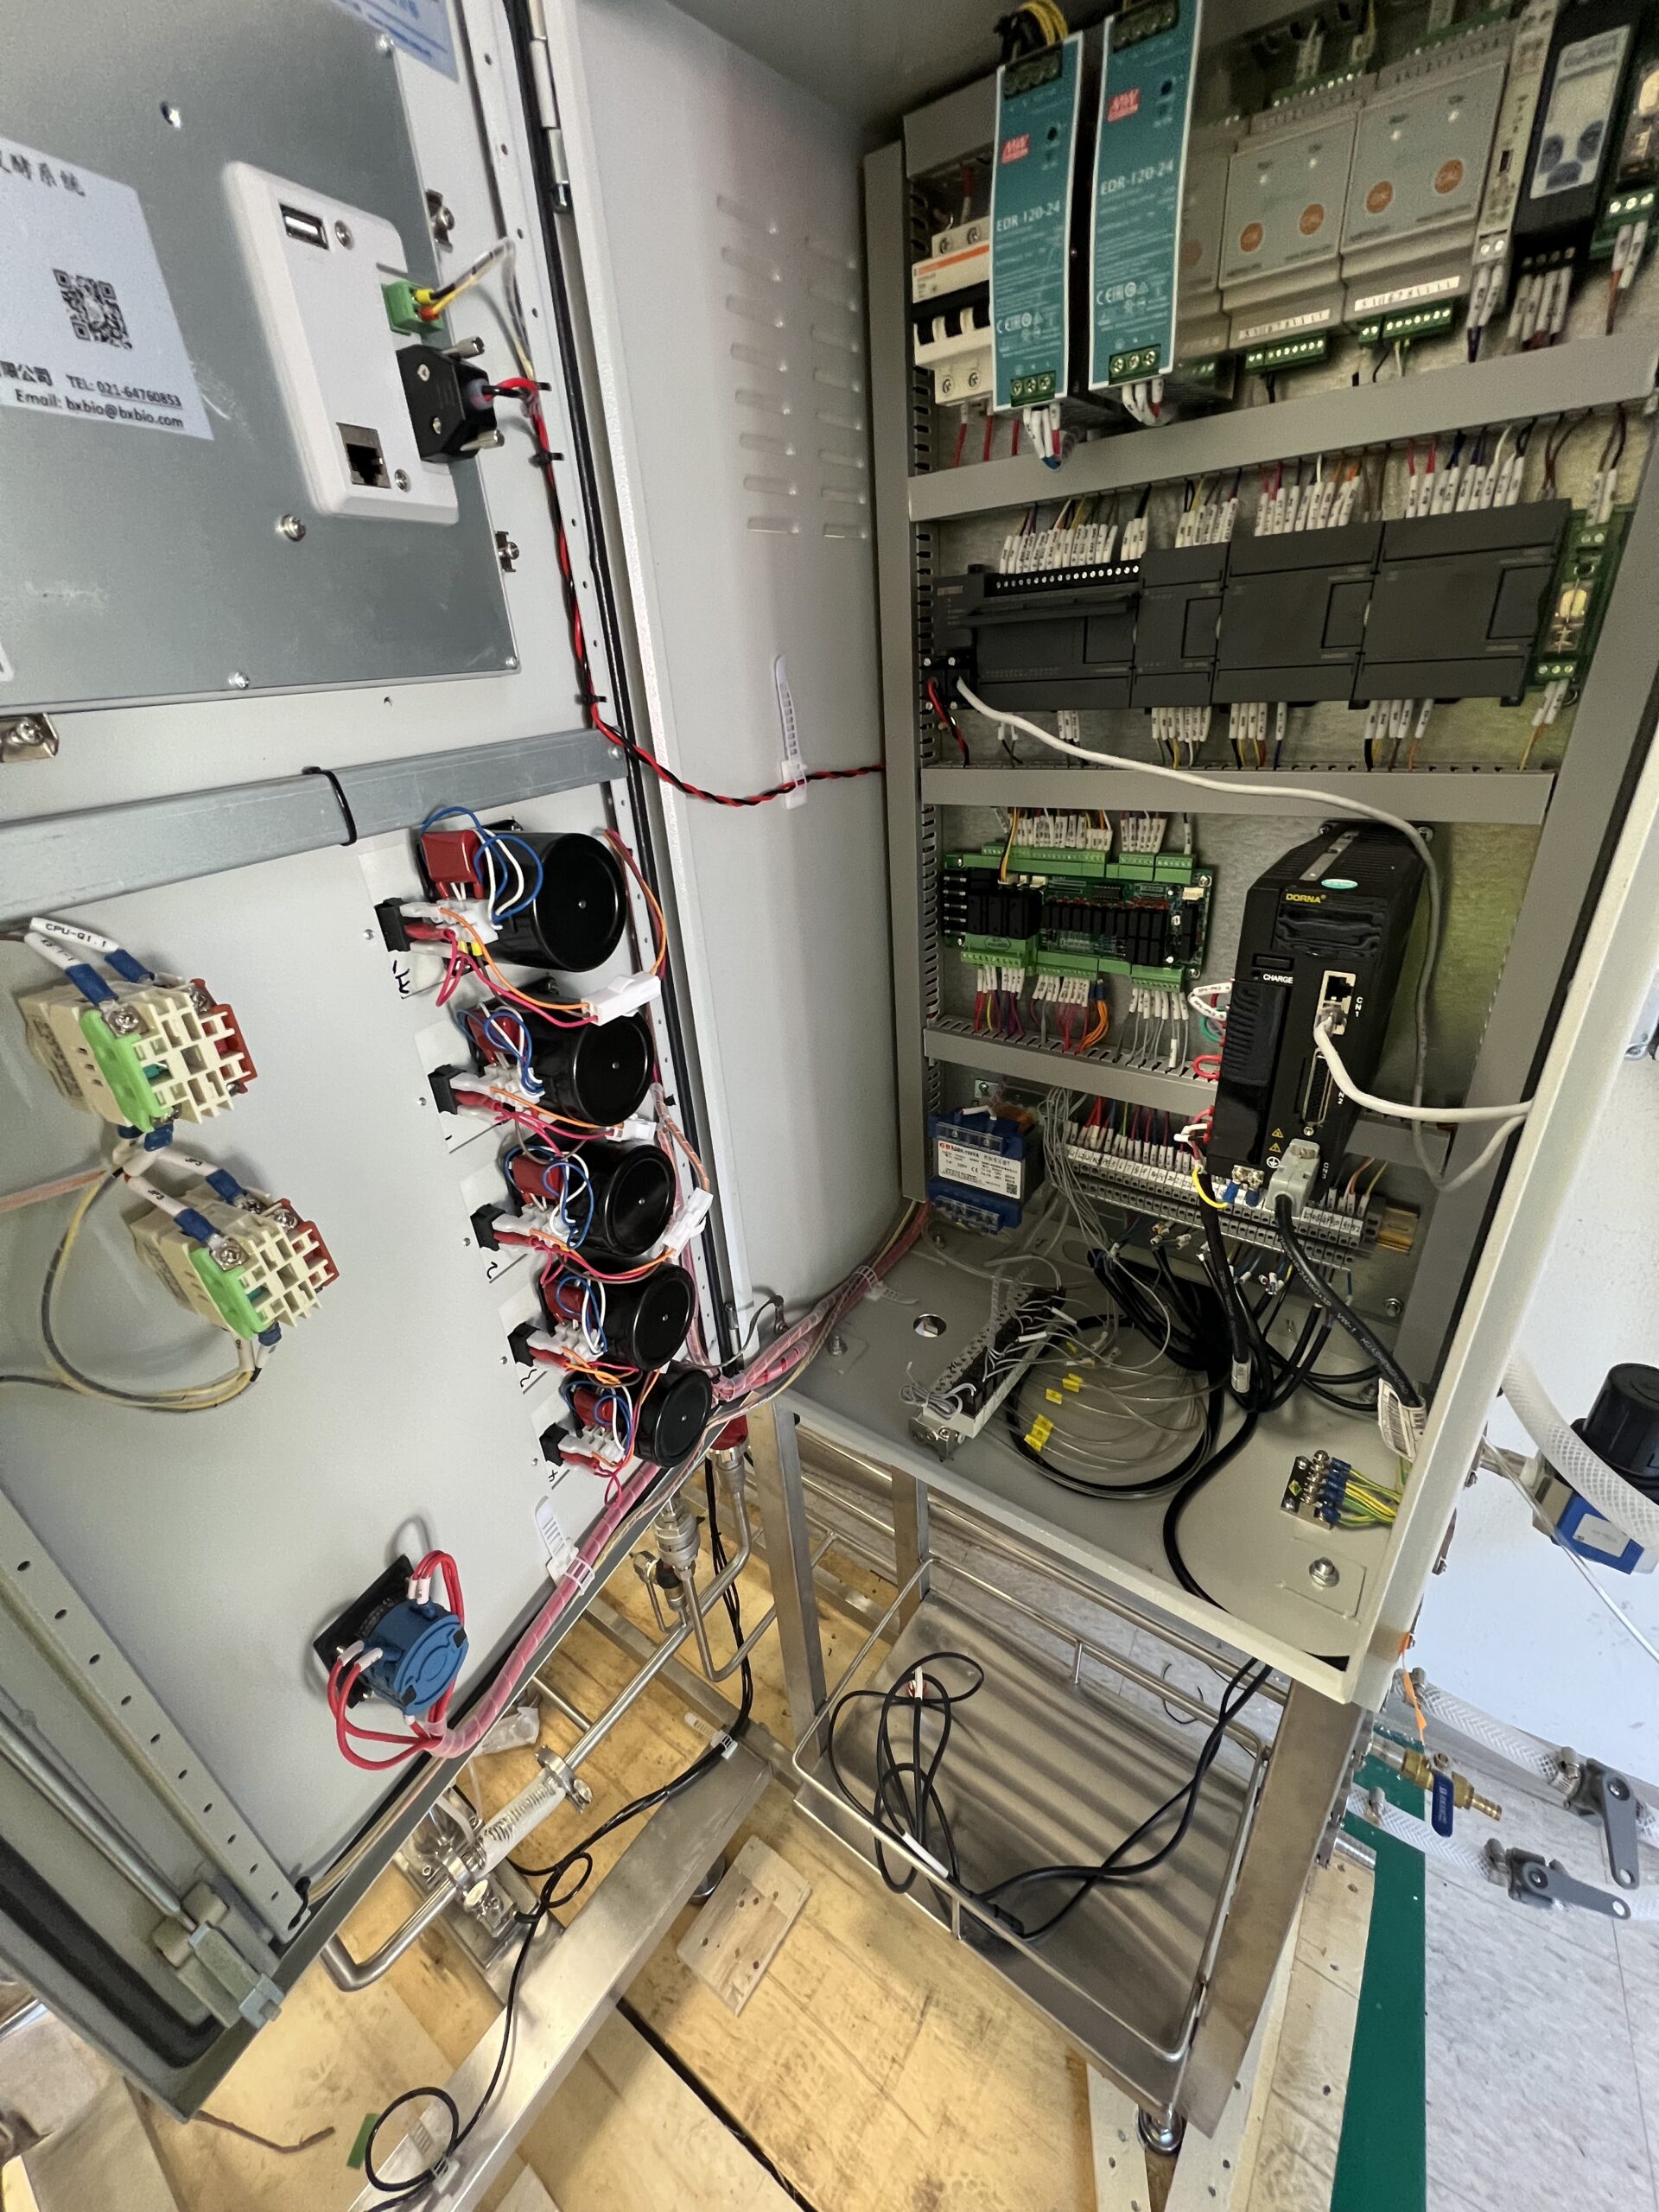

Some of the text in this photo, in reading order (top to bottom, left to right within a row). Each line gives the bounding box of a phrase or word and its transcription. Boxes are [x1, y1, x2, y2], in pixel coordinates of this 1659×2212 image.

[0, 360, 54, 387] 限公司
[66, 374, 183, 408] TEL: 021-64760853
[16, 389, 184, 429] Email: bxbio@bxbio.com
[1285, 893, 1321, 904] DORNA
[1262, 973, 1294, 984] CHARGE
[1354, 996, 1363, 1018] CN1
